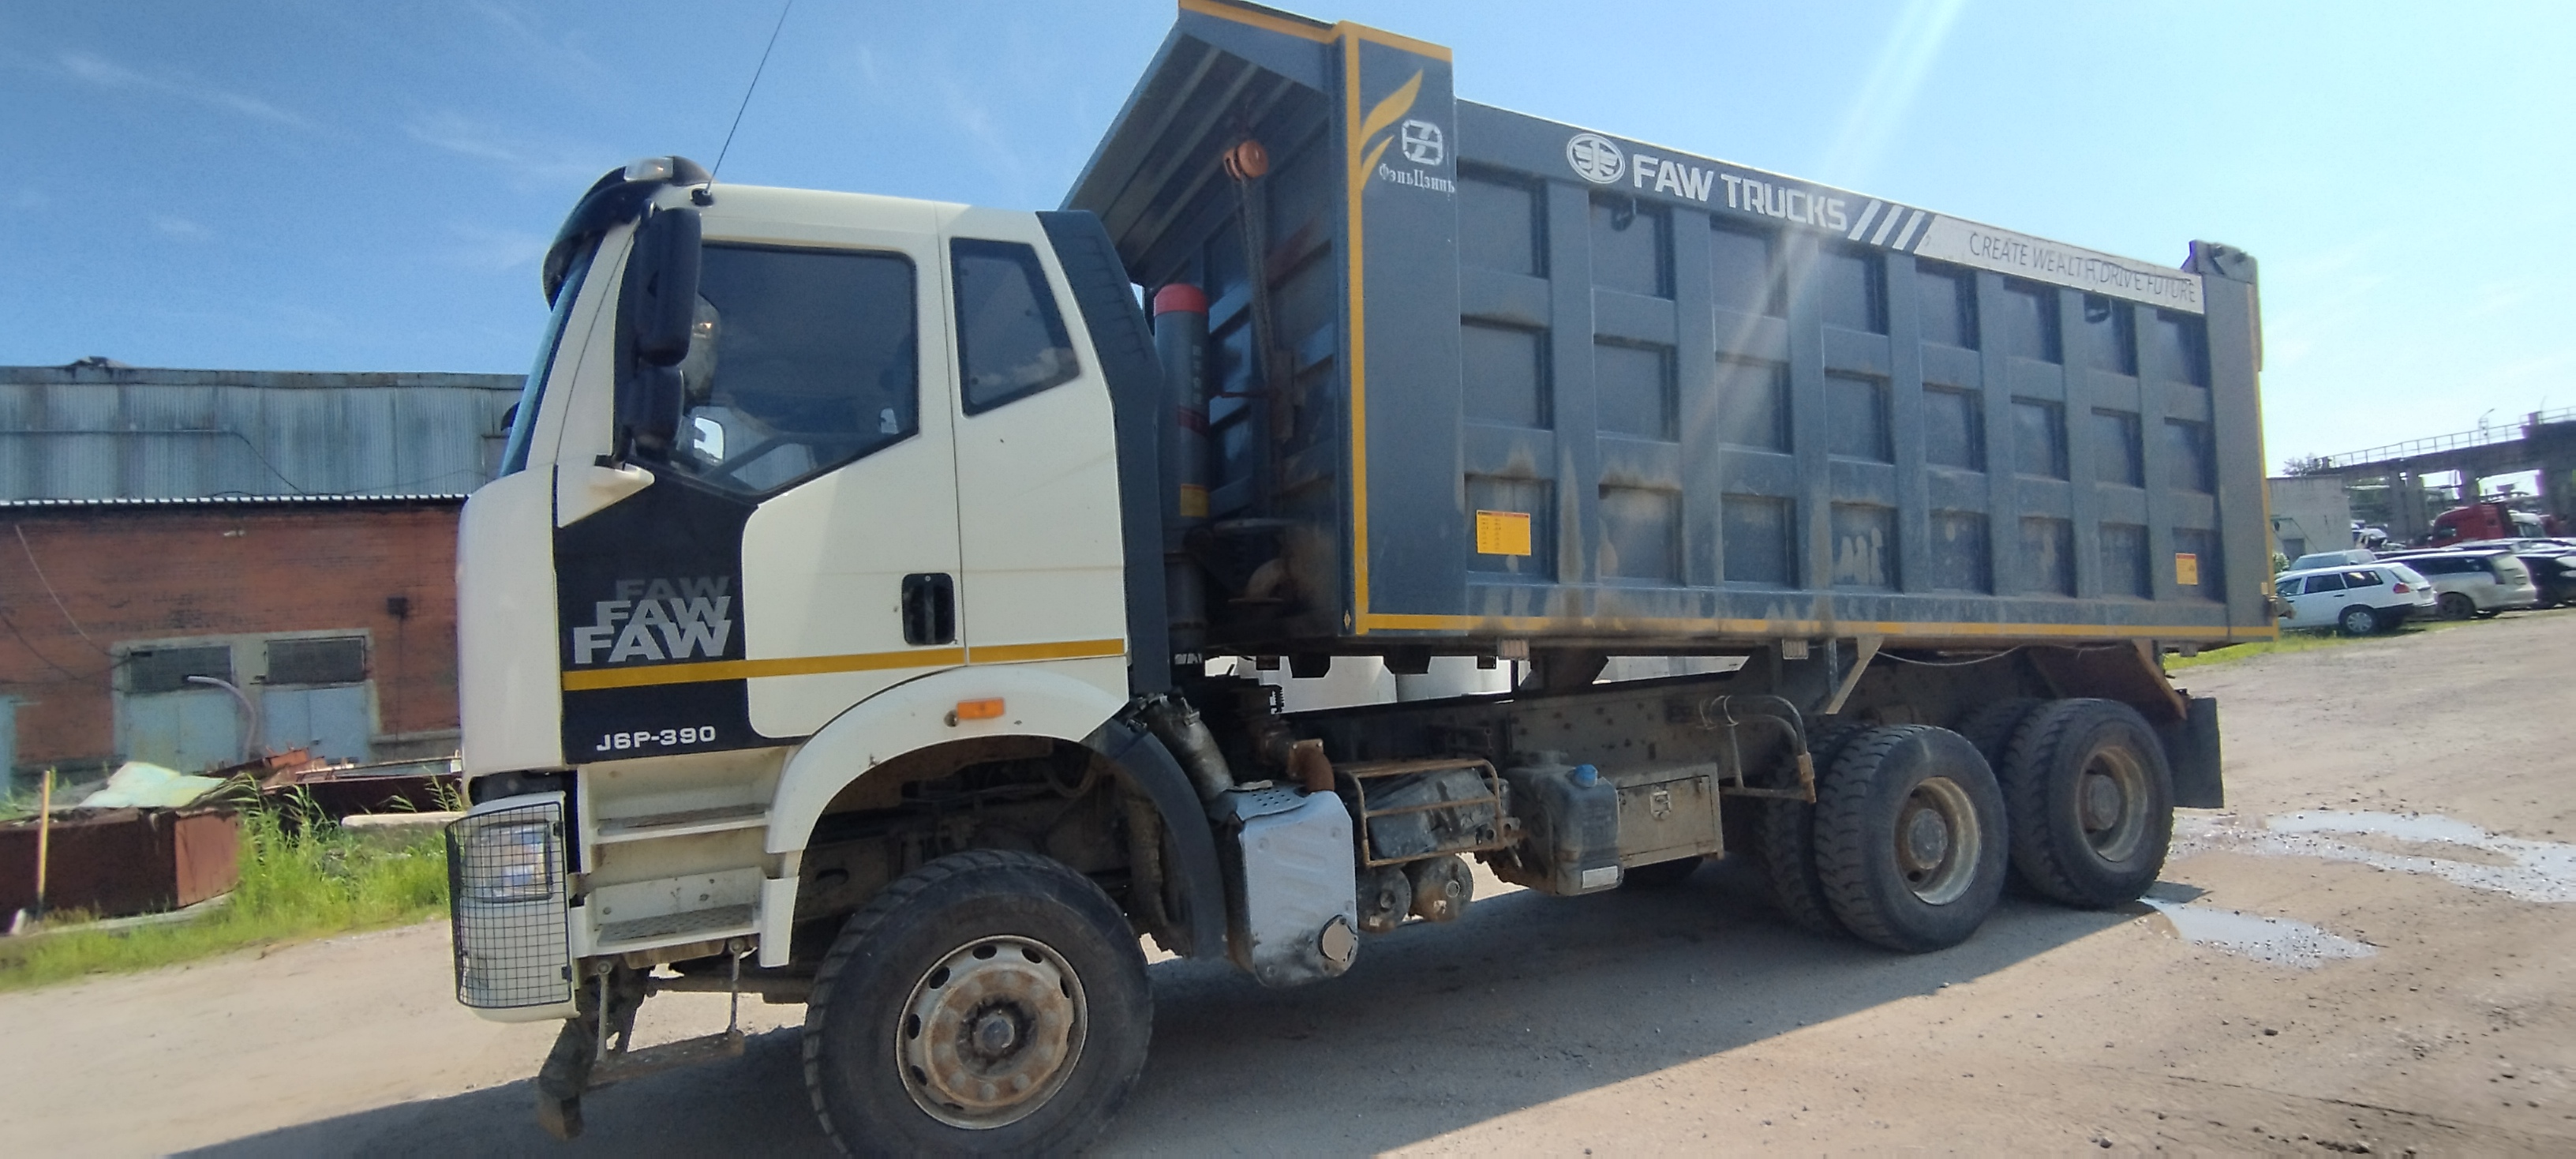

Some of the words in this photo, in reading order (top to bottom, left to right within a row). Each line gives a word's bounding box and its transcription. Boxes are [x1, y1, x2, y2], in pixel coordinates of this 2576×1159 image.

[1633, 154, 1713, 202] FAW
[1720, 173, 1848, 231] TRUCKS
[1970, 232, 2028, 266] CREATE
[2147, 274, 2196, 303] FUTURE
[616, 576, 730, 603] FAW
[597, 596, 731, 632] FAW
[574, 620, 732, 664] FAW
[596, 726, 717, 752] J6P-390
